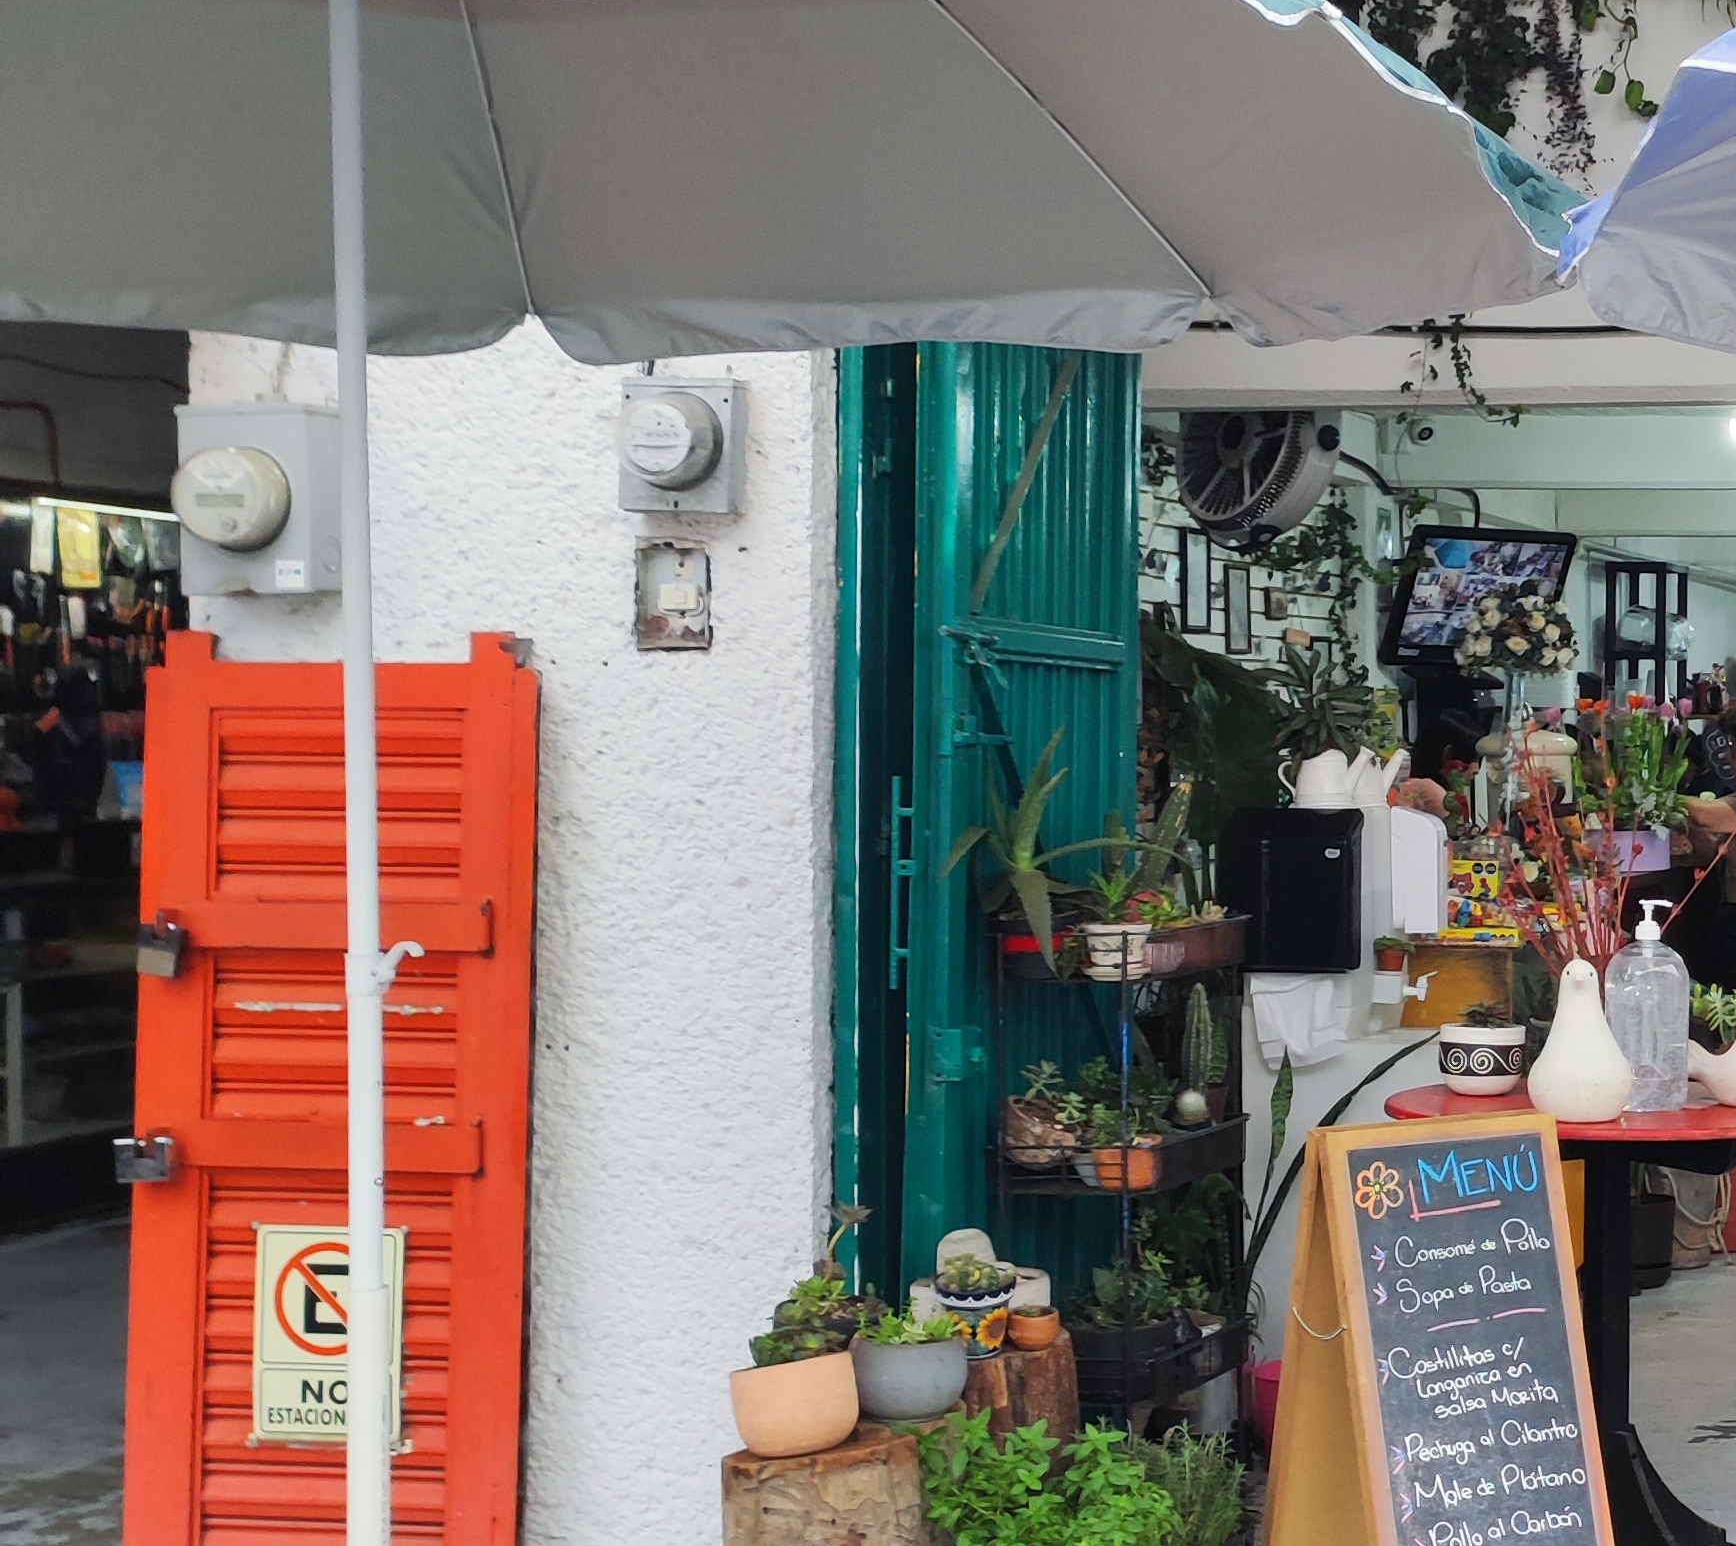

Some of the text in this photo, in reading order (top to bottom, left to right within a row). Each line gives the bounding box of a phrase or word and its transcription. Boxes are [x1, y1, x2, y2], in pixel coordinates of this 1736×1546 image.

[1417, 1143, 1538, 1204] MENÚ
[1394, 1218, 1550, 1268] Consomé de Pollo
[1396, 1264, 1532, 1313] Sopa de Pasta
[1388, 1345, 1495, 1379] Costillitas
[1507, 1362, 1533, 1378] en
[301, 1379, 348, 1404] NO
[1434, 1397, 1488, 1420] salsa
[267, 1406, 348, 1426] ESTACION
[1403, 1417, 1578, 1466] Pechuga al Cilantro
[1413, 1463, 1586, 1509] Mole de Plátano
[1487, 1517, 1506, 1539] al
[1510, 1505, 1583, 1536] Carbón
